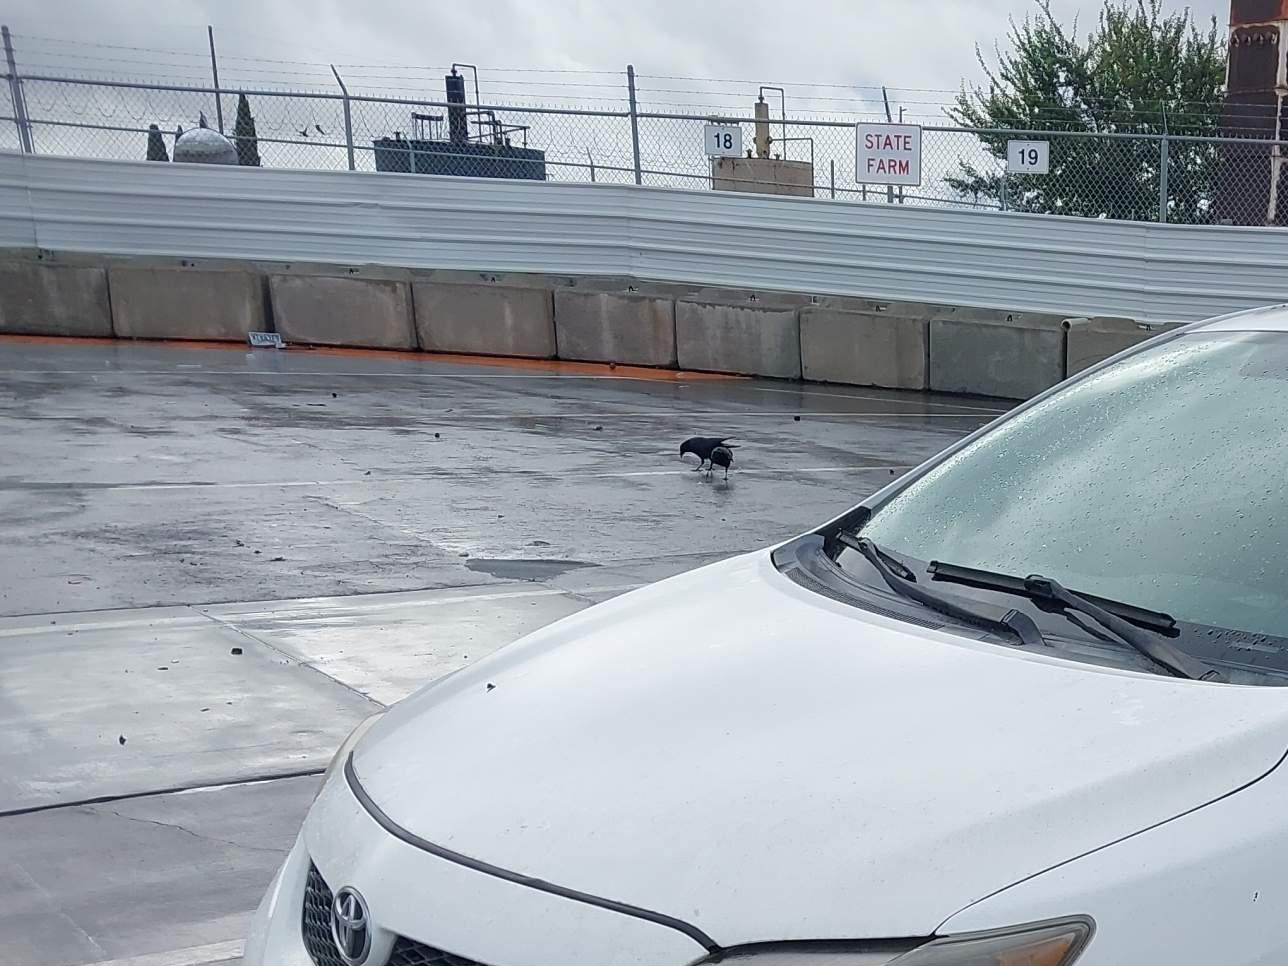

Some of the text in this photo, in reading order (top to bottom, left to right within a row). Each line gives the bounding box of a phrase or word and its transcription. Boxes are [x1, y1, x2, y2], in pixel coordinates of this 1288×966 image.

[713, 132, 733, 149] 18
[865, 133, 912, 151] STATE
[1018, 148, 1039, 165] 19
[867, 158, 910, 175] FARM
